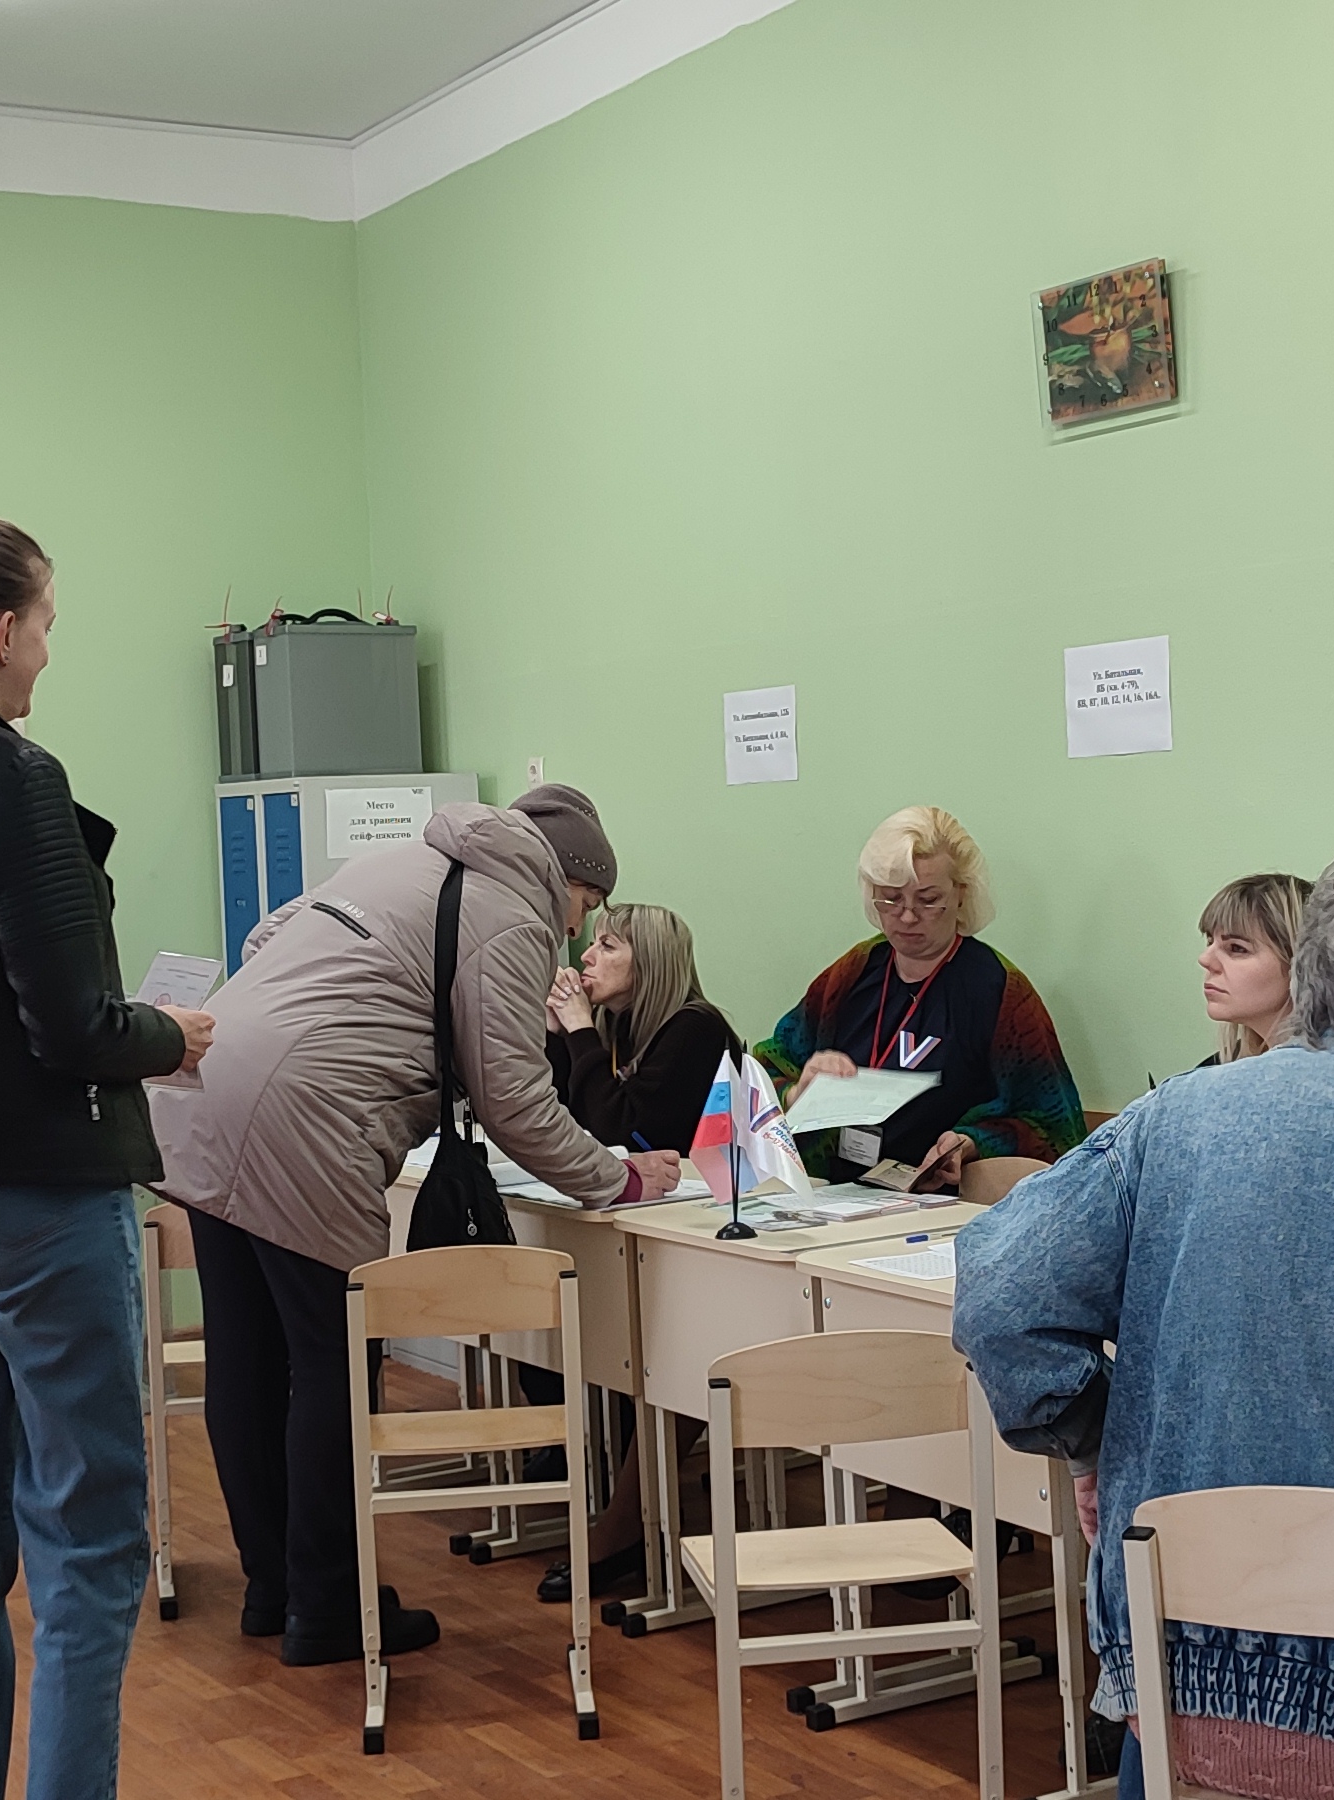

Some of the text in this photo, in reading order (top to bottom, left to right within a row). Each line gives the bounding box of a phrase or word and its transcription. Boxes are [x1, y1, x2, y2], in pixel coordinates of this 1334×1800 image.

[1088, 283, 1100, 298] 12
[1066, 295, 1078, 307] 11
[1139, 294, 1147, 307] 2
[1046, 318, 1058, 333] 10
[1151, 325, 1158, 337] 3
[1043, 353, 1050, 366] 9
[1146, 362, 1153, 375] 4
[1058, 383, 1065, 396] 8
[1122, 383, 1129, 397] 5
[1079, 394, 1086, 408] 7
[1100, 394, 1108, 407] 6
[366, 801, 394, 810] Место
[349, 816, 412, 827] для хранения
[349, 831, 412, 841] сейф-пакетов
